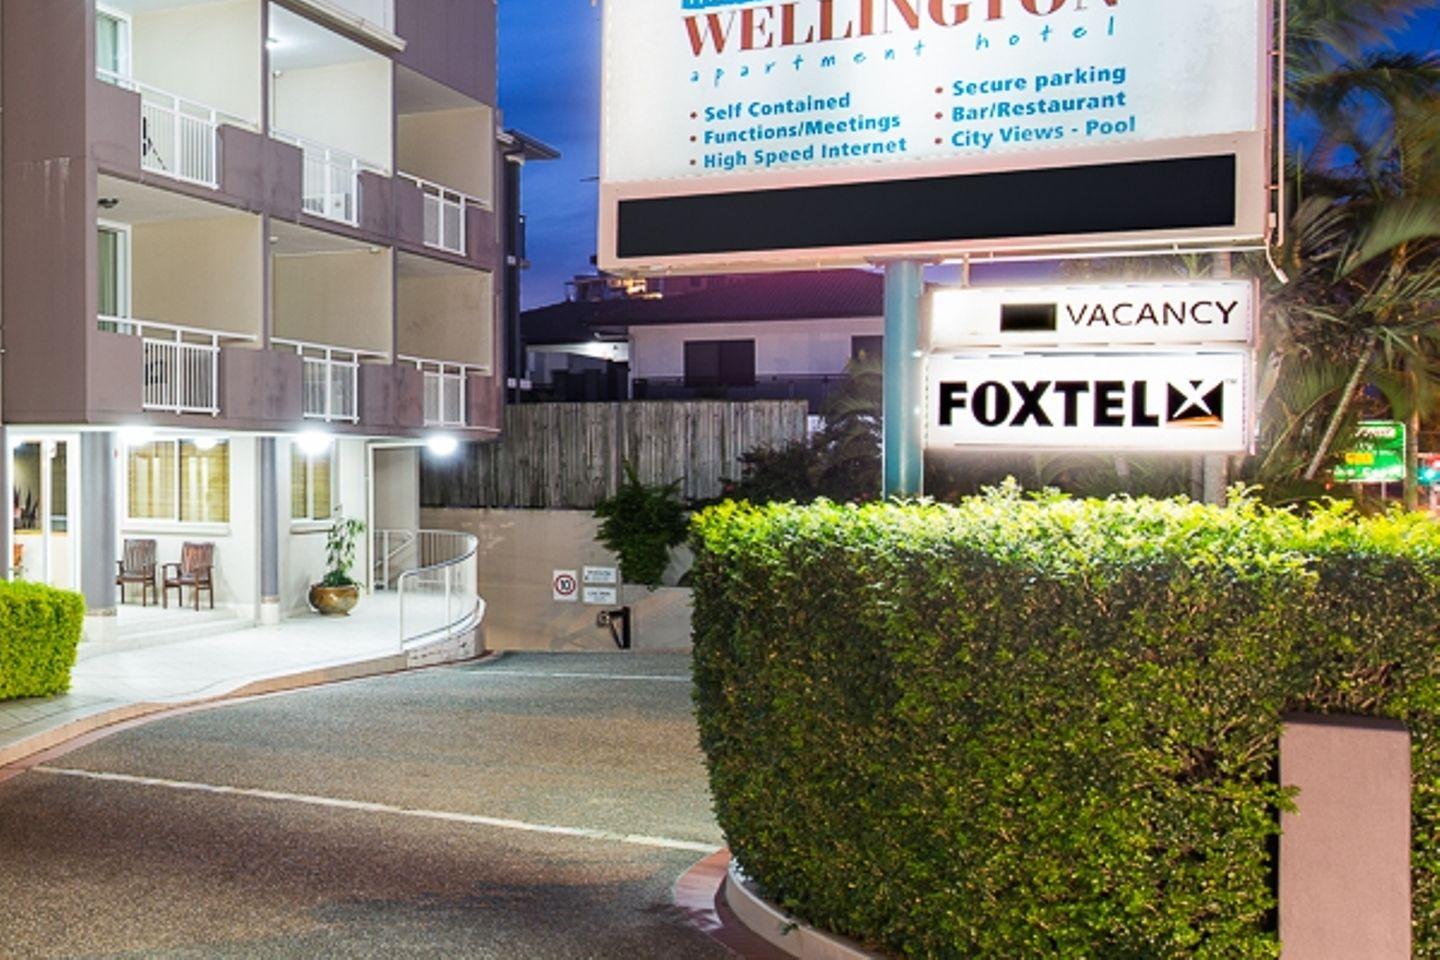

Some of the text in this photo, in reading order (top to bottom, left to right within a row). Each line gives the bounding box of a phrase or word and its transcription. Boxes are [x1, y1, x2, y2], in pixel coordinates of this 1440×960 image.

[690, 15, 1115, 87] apartment hotel
[952, 66, 1126, 96] Secure parking
[704, 92, 851, 122] Self Contained
[952, 91, 1127, 122] Bar/Restaurant
[704, 114, 901, 144] Functions/Meetings
[951, 130, 994, 149] City
[999, 124, 1064, 142] Views
[1086, 115, 1136, 136] Pool
[704, 137, 907, 171] High Speed Internet
[1066, 301, 1239, 327] VACANCY
[939, 381, 1160, 427] FOXTEL
[561, 580, 570, 590] 10
